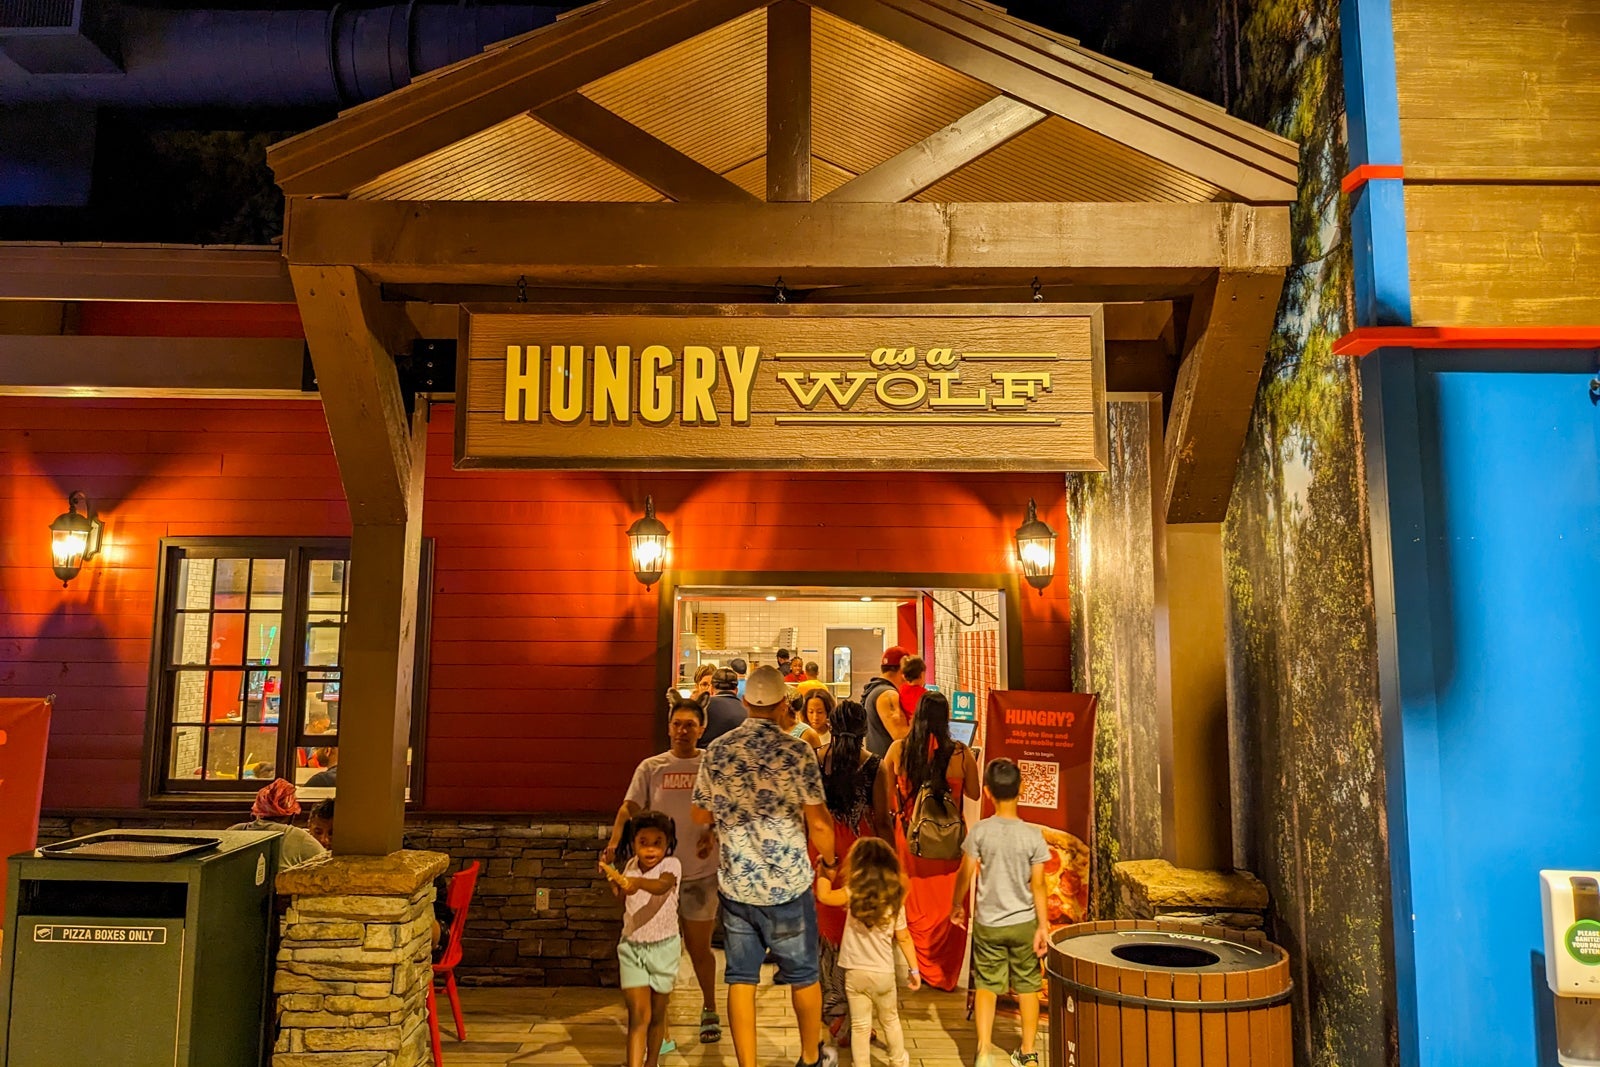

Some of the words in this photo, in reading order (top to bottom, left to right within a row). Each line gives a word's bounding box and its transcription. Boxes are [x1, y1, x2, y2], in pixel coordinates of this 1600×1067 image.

[869, 345, 917, 368] as
[923, 346, 957, 368] a
[504, 345, 762, 423] HUNGRY
[776, 371, 1050, 408] WOLF
[1005, 709, 1075, 727] HUNGRY?
[1012, 730, 1026, 738] Skip
[664, 774, 697, 788] MARV
[62, 928, 92, 940] PIZZA
[94, 929, 126, 941] BOXES
[128, 930, 154, 942] ONLY
[1169, 933, 1224, 945] WASTE
[1067, 1040, 1076, 1067] WA
